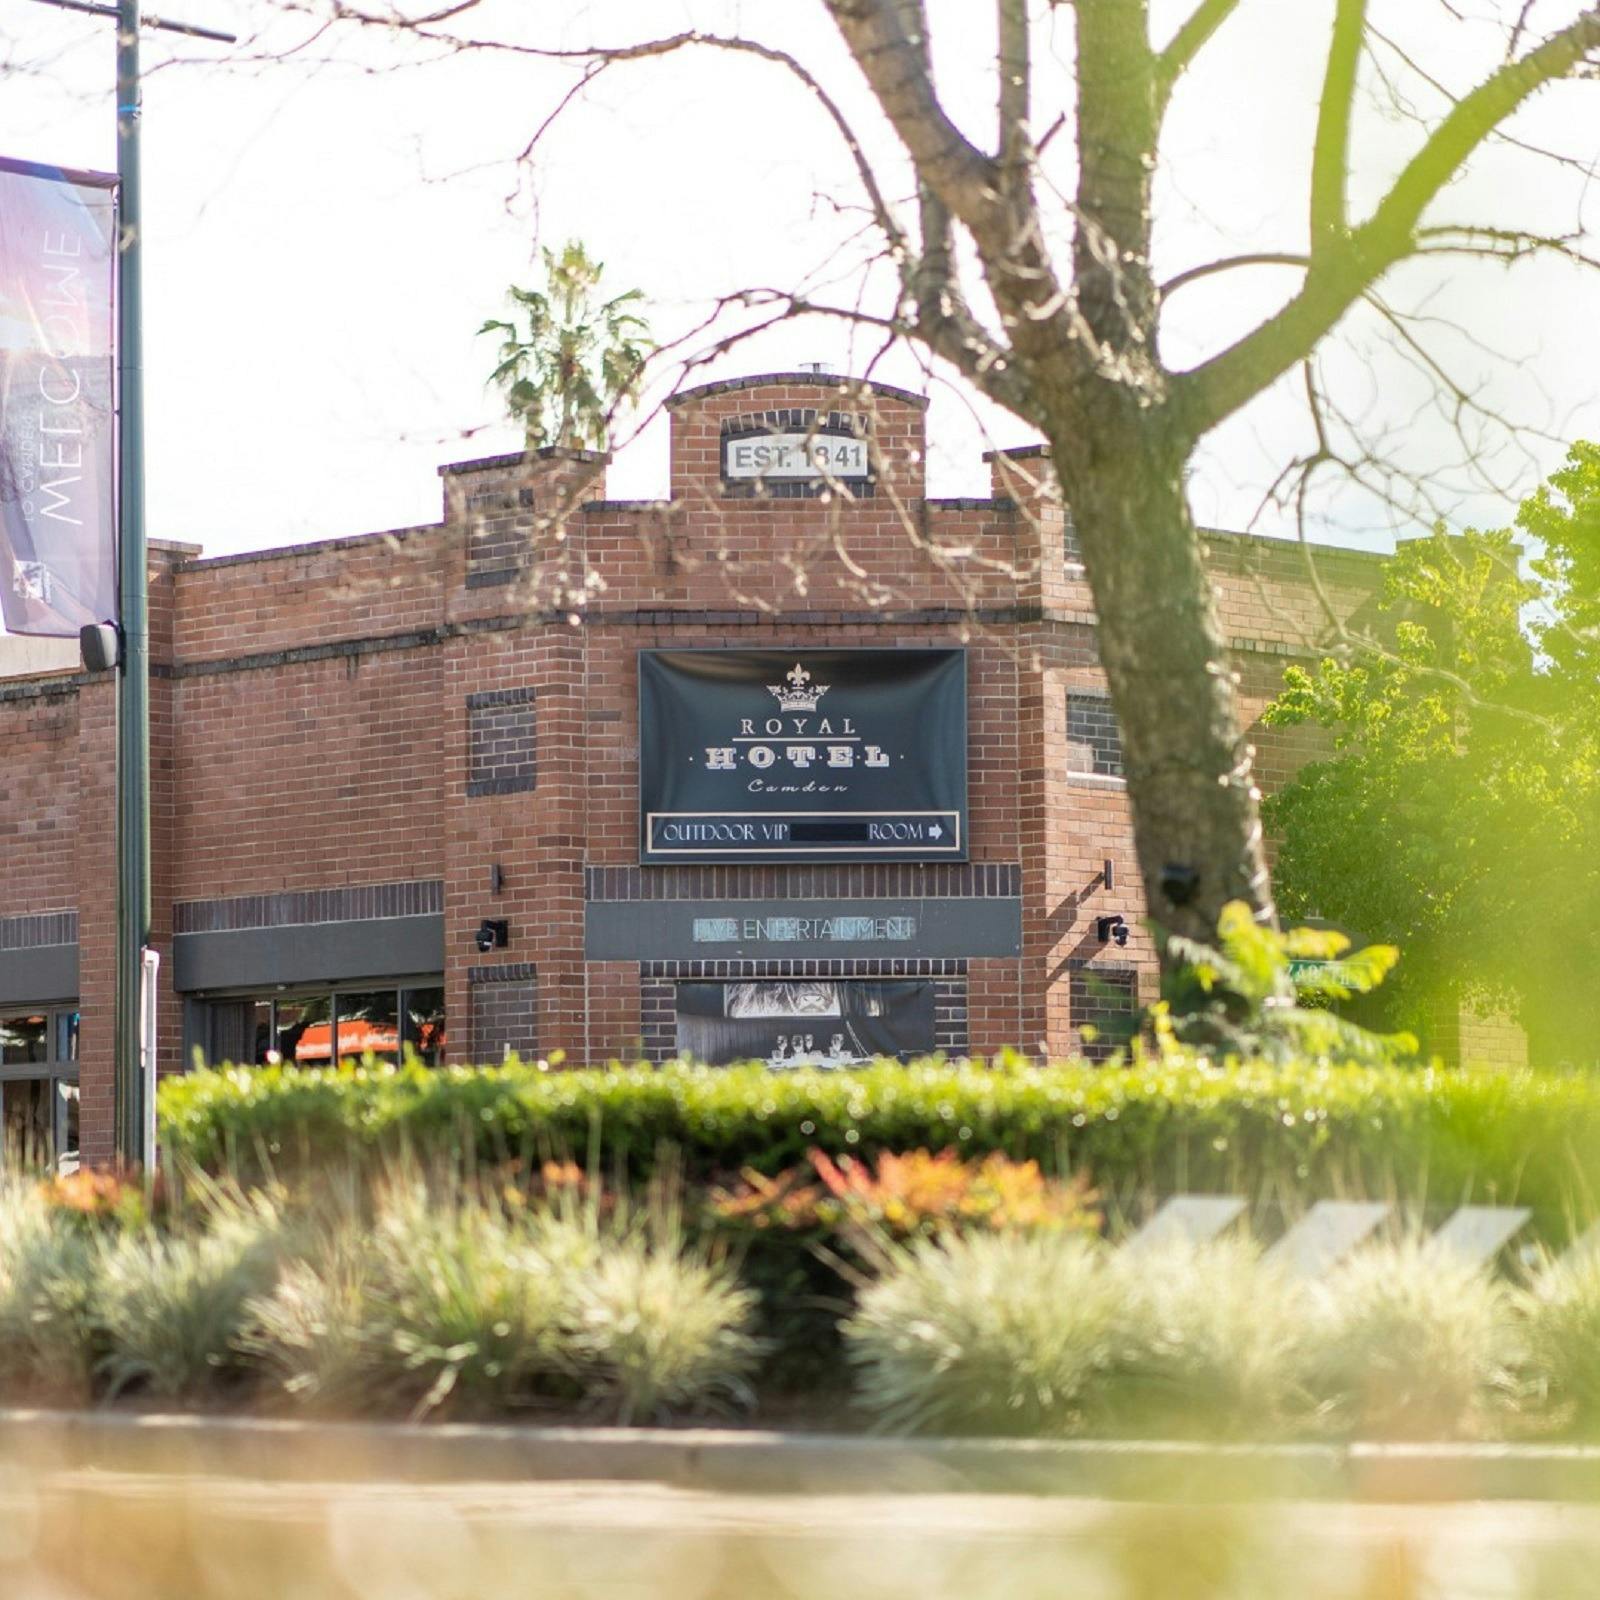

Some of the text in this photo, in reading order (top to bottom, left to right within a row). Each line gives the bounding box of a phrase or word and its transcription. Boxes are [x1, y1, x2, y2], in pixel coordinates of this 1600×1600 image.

[735, 445, 791, 468] EST.
[741, 718, 856, 735] ROYAL
[747, 778, 848, 793] Camden
[663, 823, 923, 841] OUTDOOR VIP ROOM
